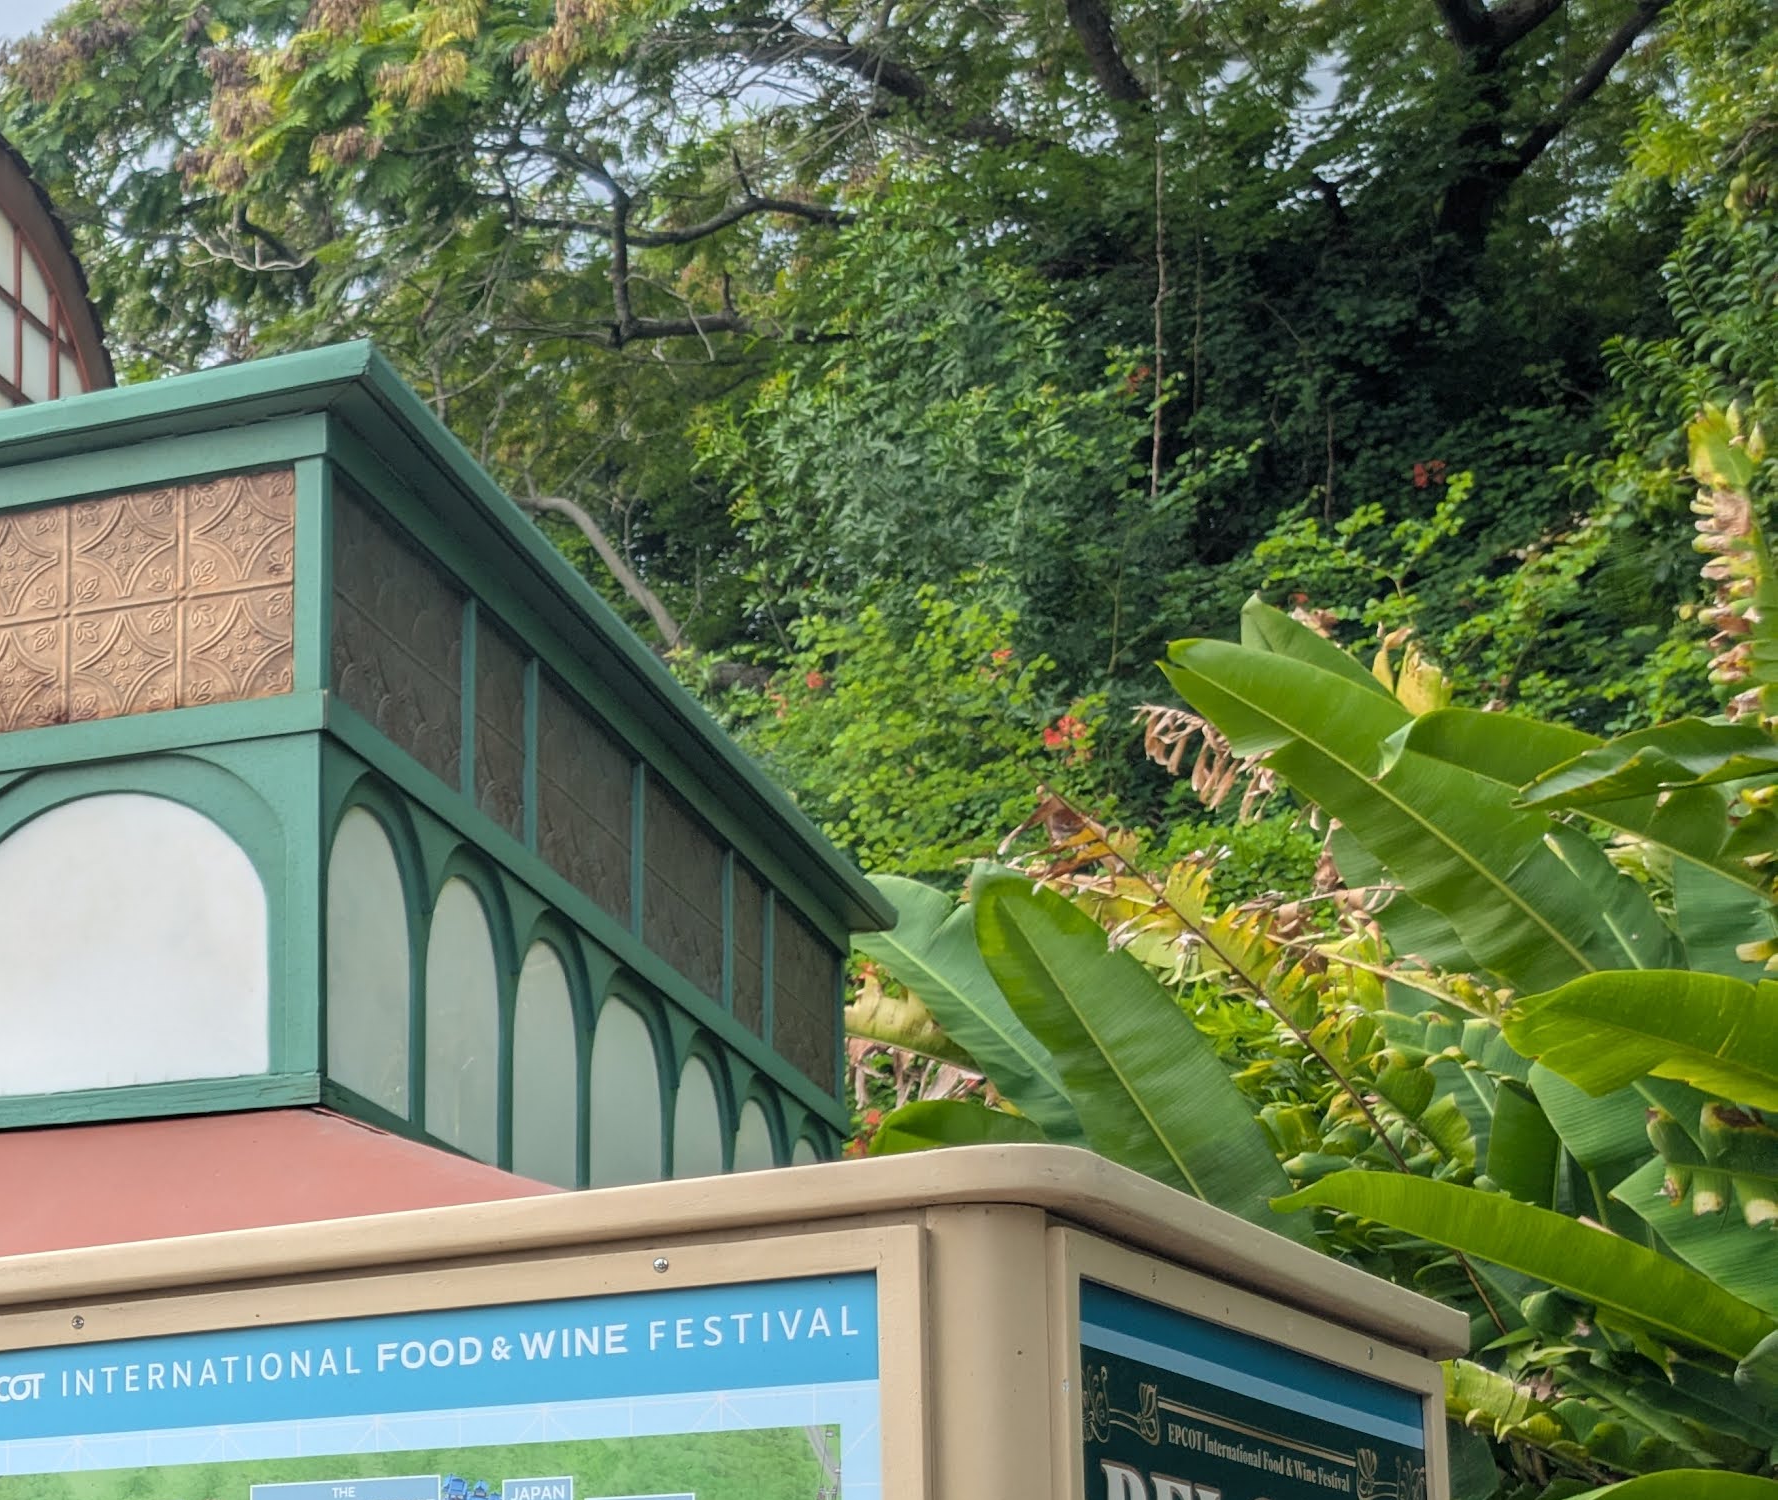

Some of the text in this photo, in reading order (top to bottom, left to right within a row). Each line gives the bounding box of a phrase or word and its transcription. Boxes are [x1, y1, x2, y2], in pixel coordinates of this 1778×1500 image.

[61, 1345, 361, 1399] INTERNATIONAL
[377, 1336, 482, 1373] FOOD
[492, 1337, 512, 1360] &
[521, 1324, 628, 1360] WINE
[649, 1306, 858, 1351] FESTIVAL
[332, 1486, 355, 1498] THE
[1168, 1422, 1350, 1493] EPCOT International Food & Wine Festival
